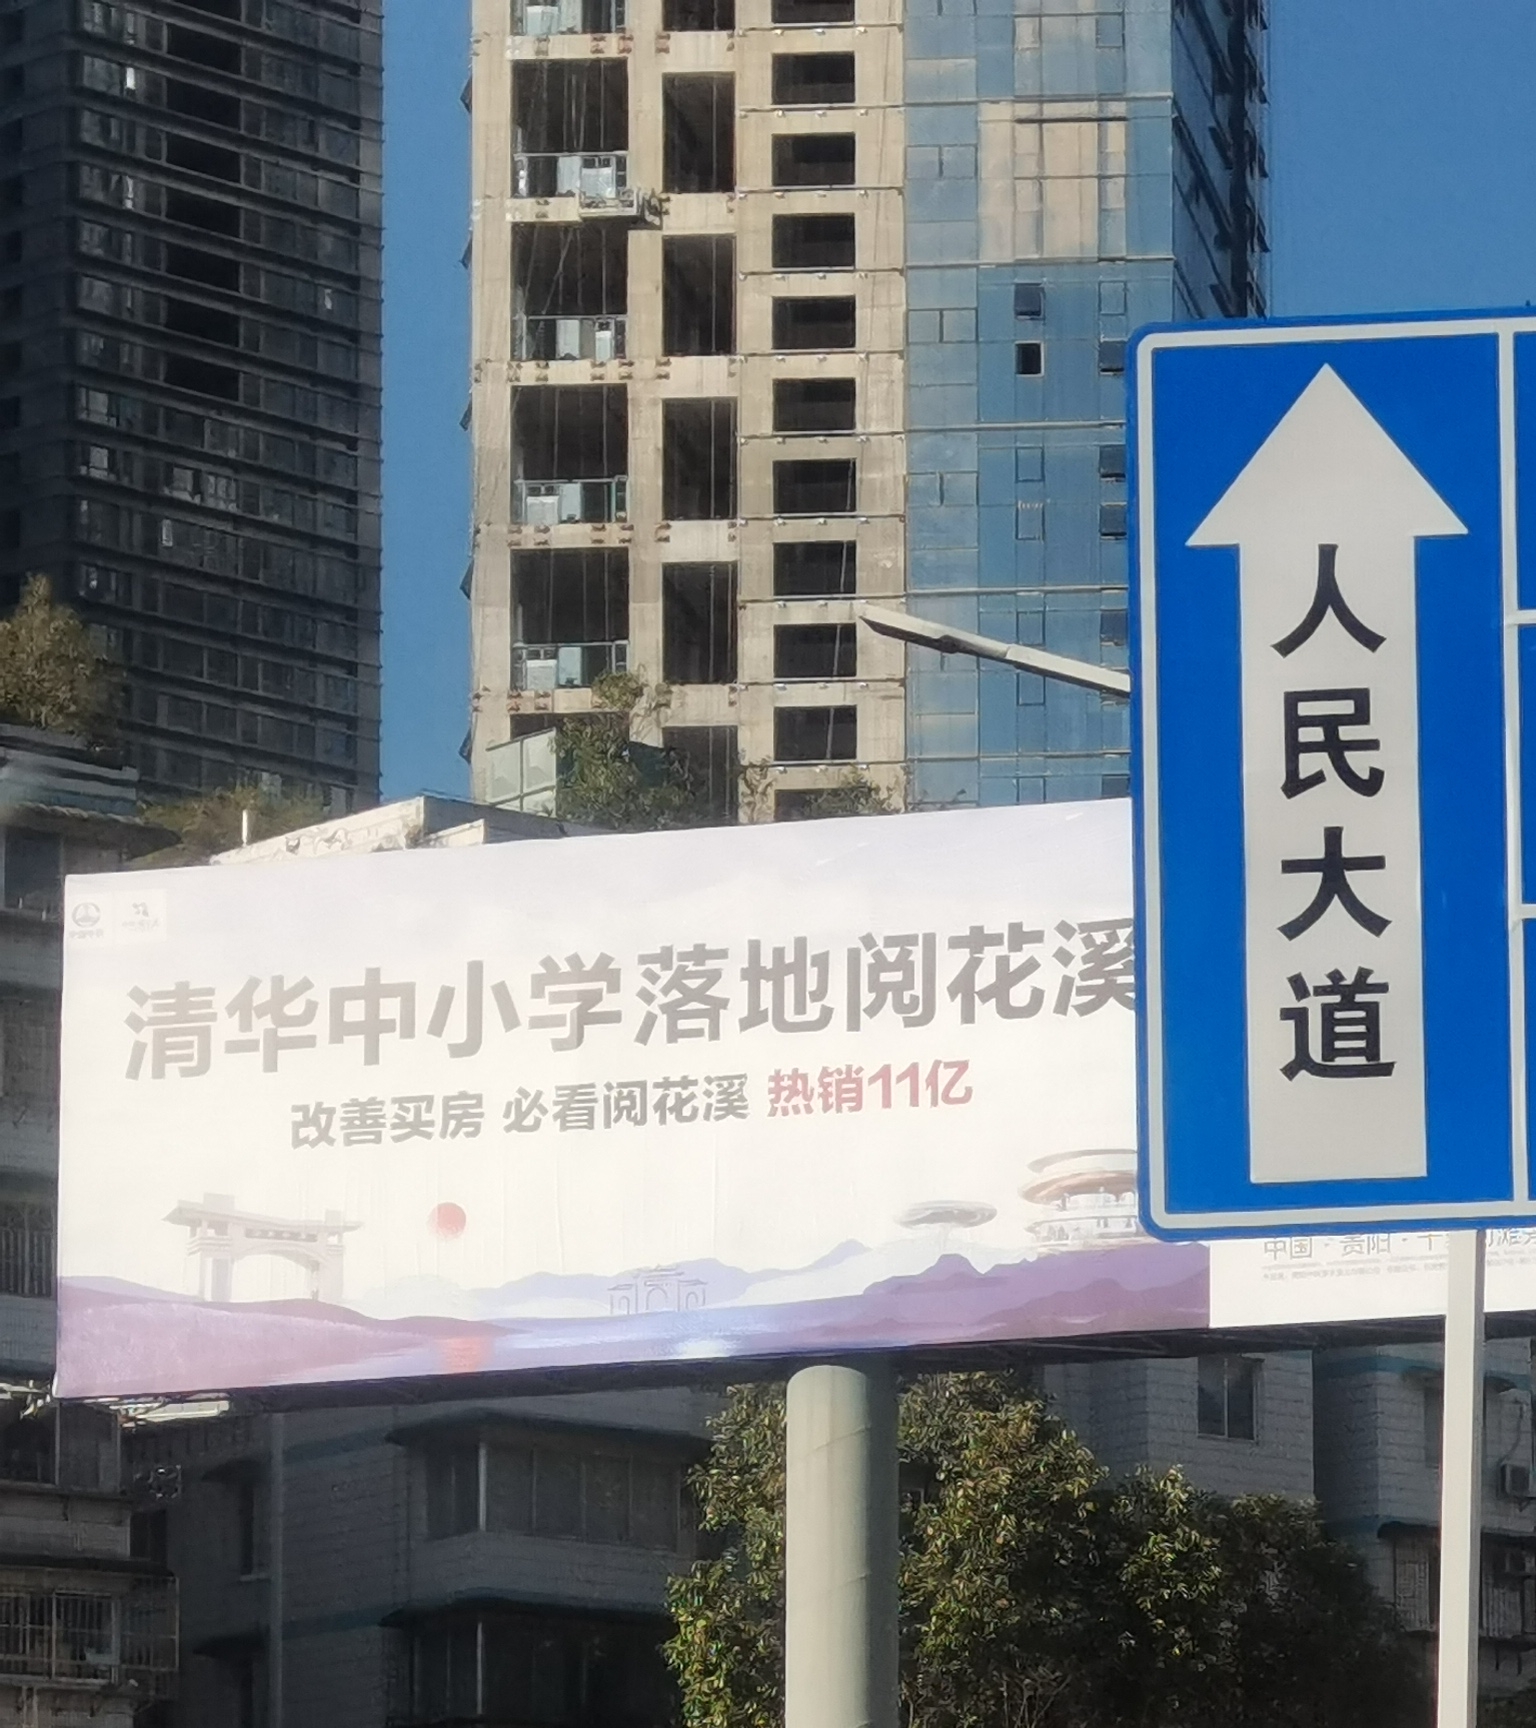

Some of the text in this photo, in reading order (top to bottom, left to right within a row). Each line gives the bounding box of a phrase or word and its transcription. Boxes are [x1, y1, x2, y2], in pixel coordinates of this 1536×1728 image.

[1273, 544, 1396, 1080] 人民大道
[124, 917, 1136, 1081] 清华中小学落地阅花溪
[291, 1059, 974, 1150] 改善买房 必看阅花溪 热销11亿
